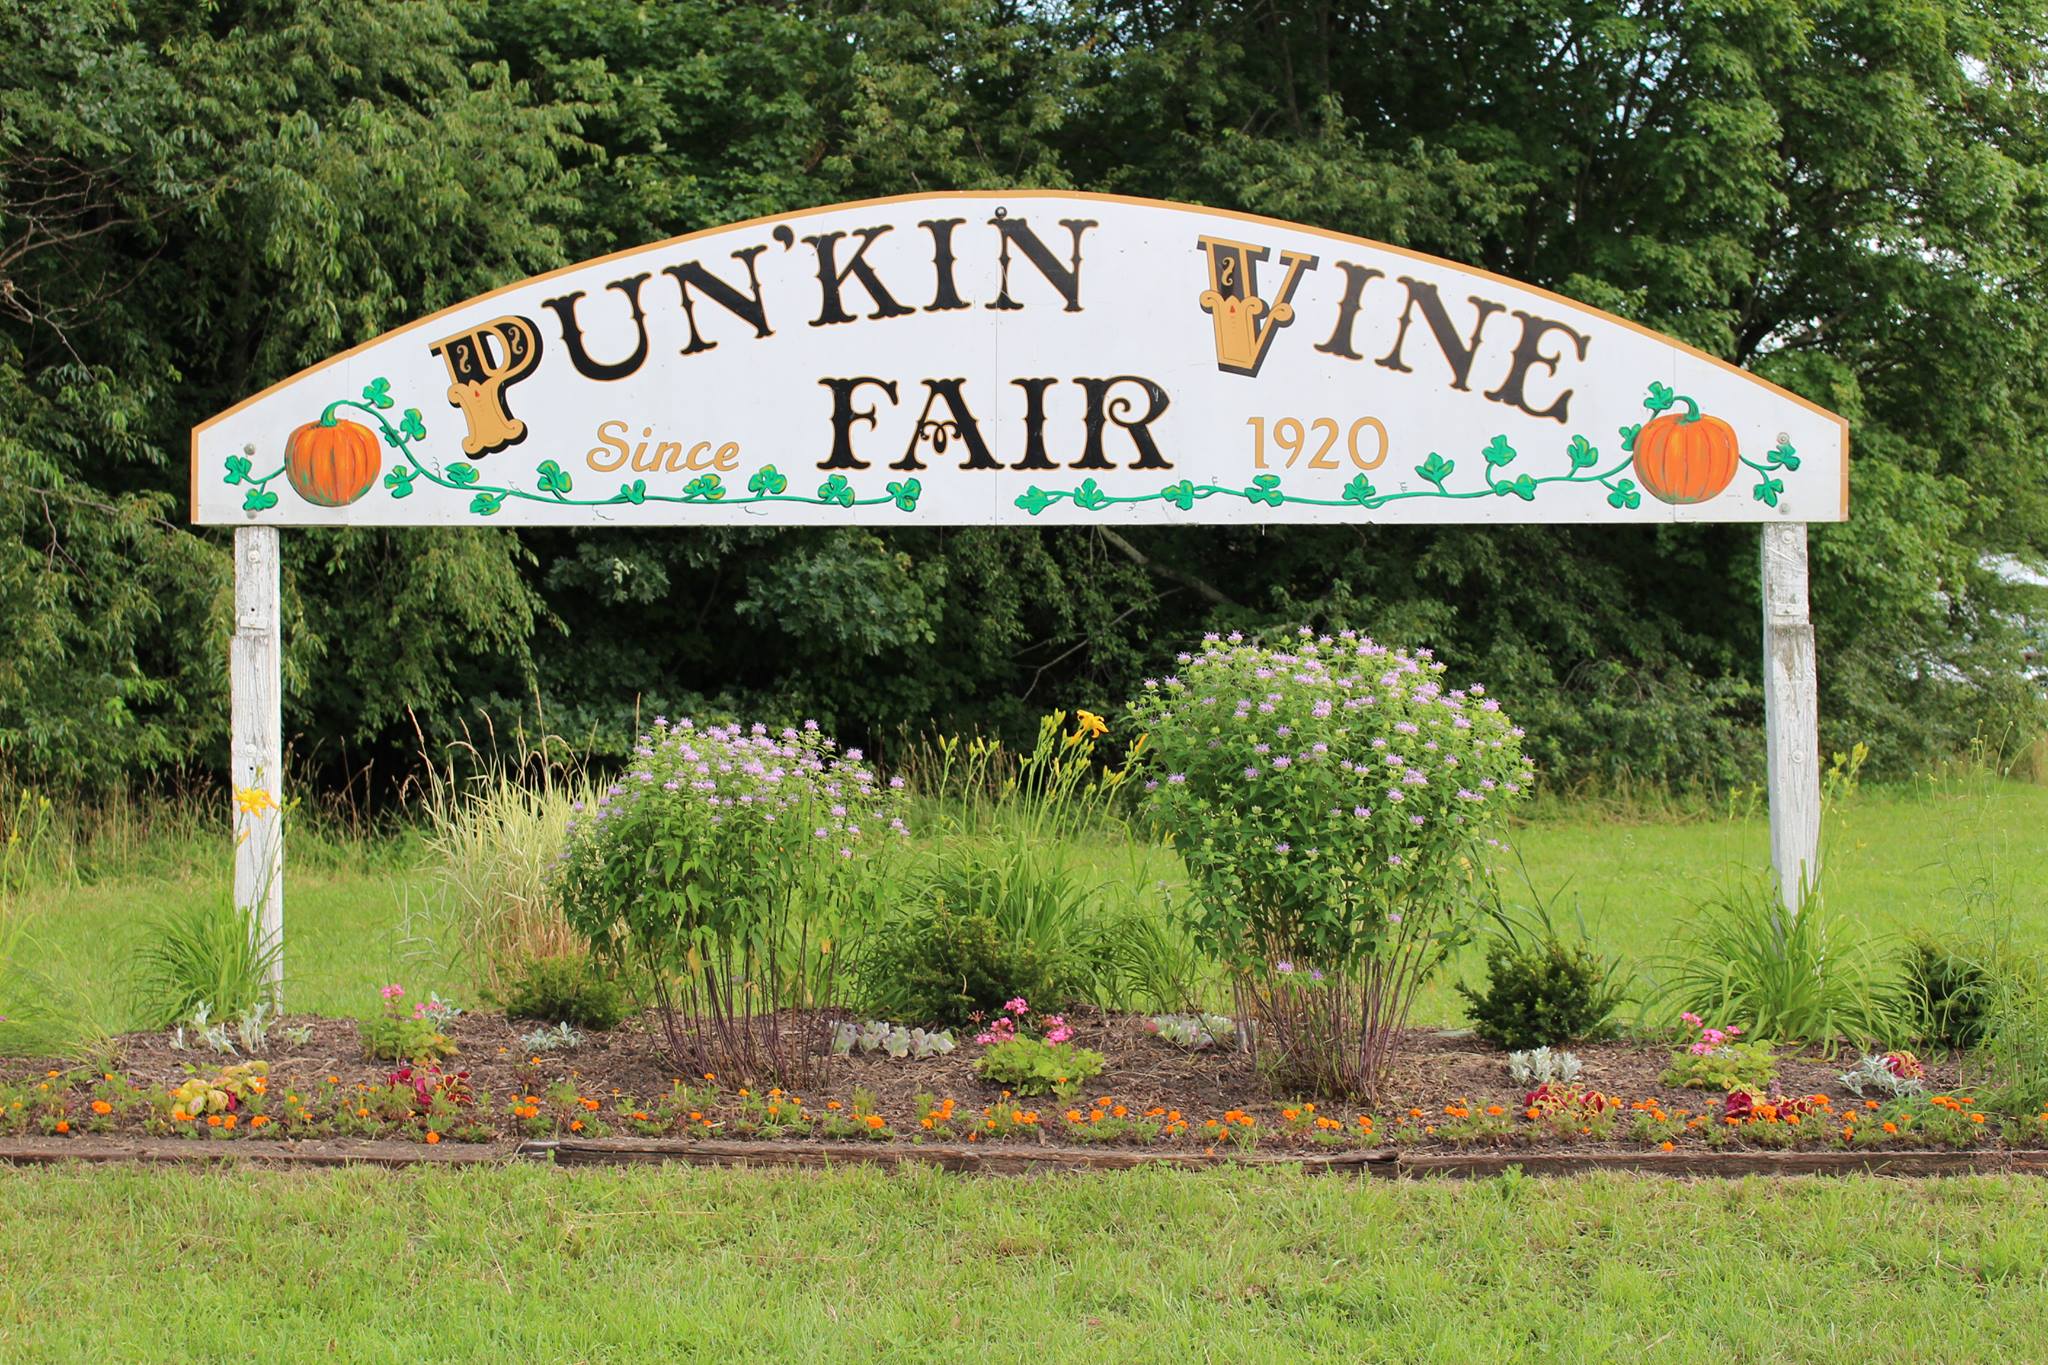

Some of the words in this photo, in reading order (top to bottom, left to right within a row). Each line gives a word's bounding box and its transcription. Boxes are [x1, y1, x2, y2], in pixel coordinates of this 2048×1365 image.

[429, 217, 1099, 460] PUN'KIN
[1196, 234, 1592, 424] VINE
[586, 420, 741, 473] Since
[1247, 416, 1390, 469] 1920
[816, 376, 1173, 469] FAIR
